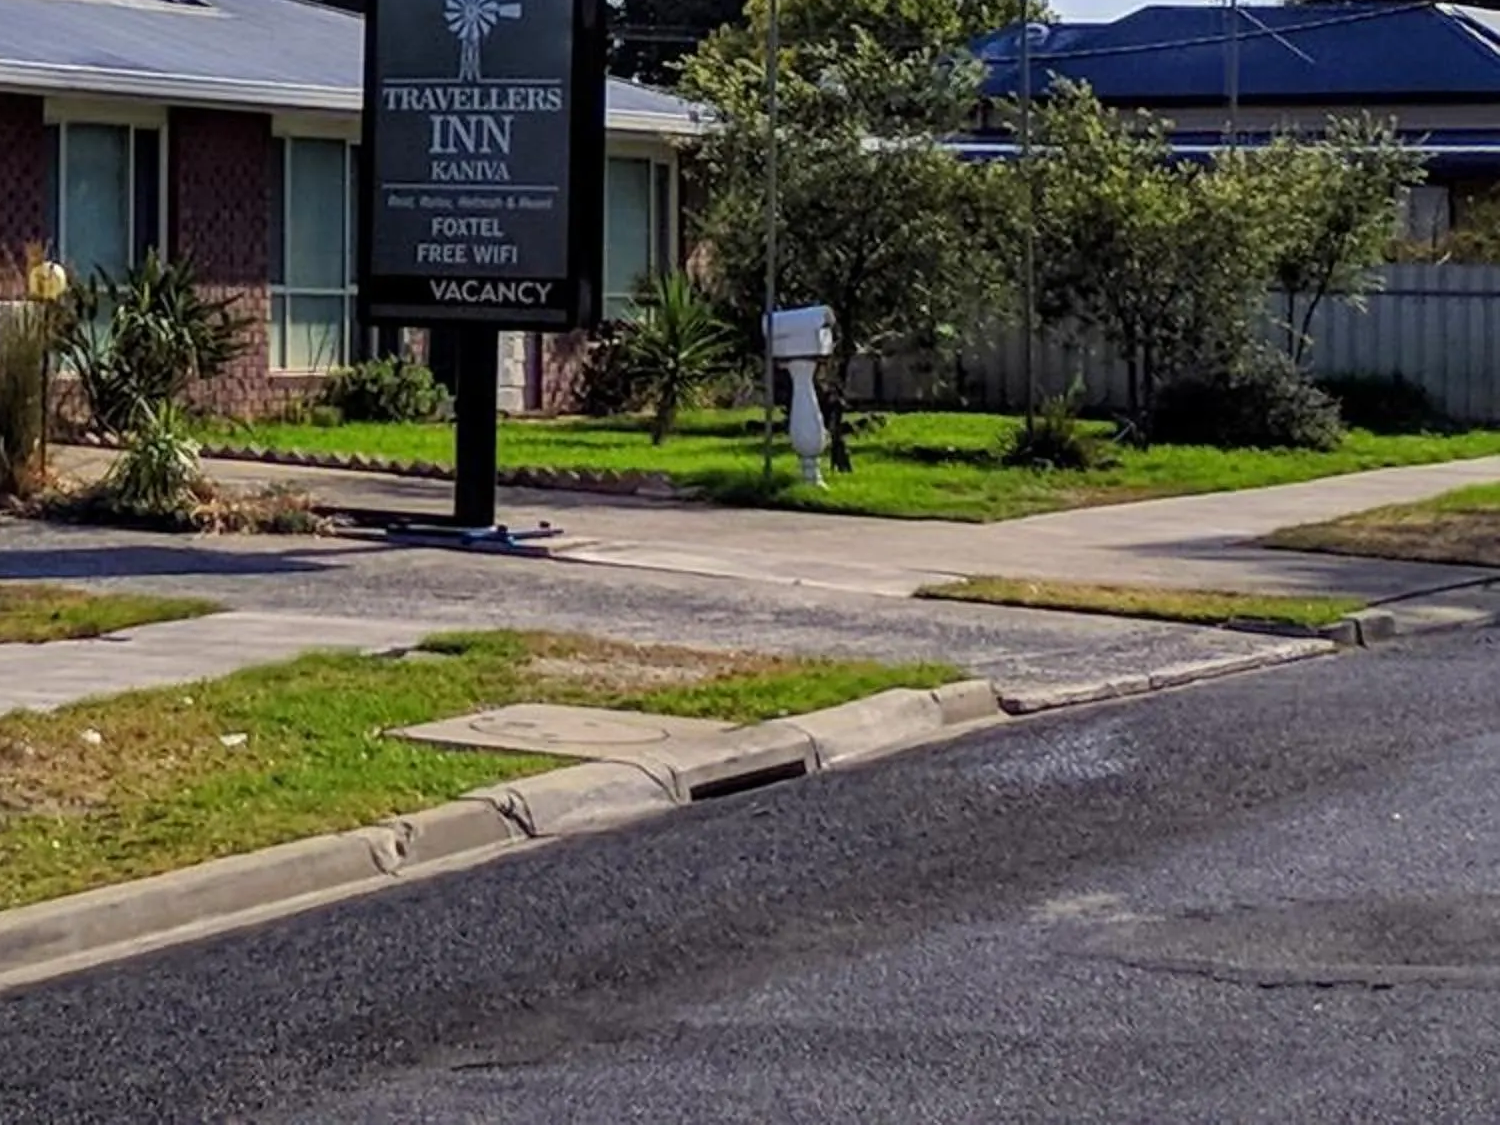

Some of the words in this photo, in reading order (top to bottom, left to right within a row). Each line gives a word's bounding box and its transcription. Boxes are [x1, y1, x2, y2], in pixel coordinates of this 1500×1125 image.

[382, 86, 563, 112] TRAVELLERS
[429, 114, 514, 155] INN
[431, 160, 511, 181] KANIVA
[431, 217, 505, 237] FOXTEL
[417, 243, 468, 263] FREE
[473, 243, 518, 264] WIFI
[429, 279, 553, 305] VACANCY
